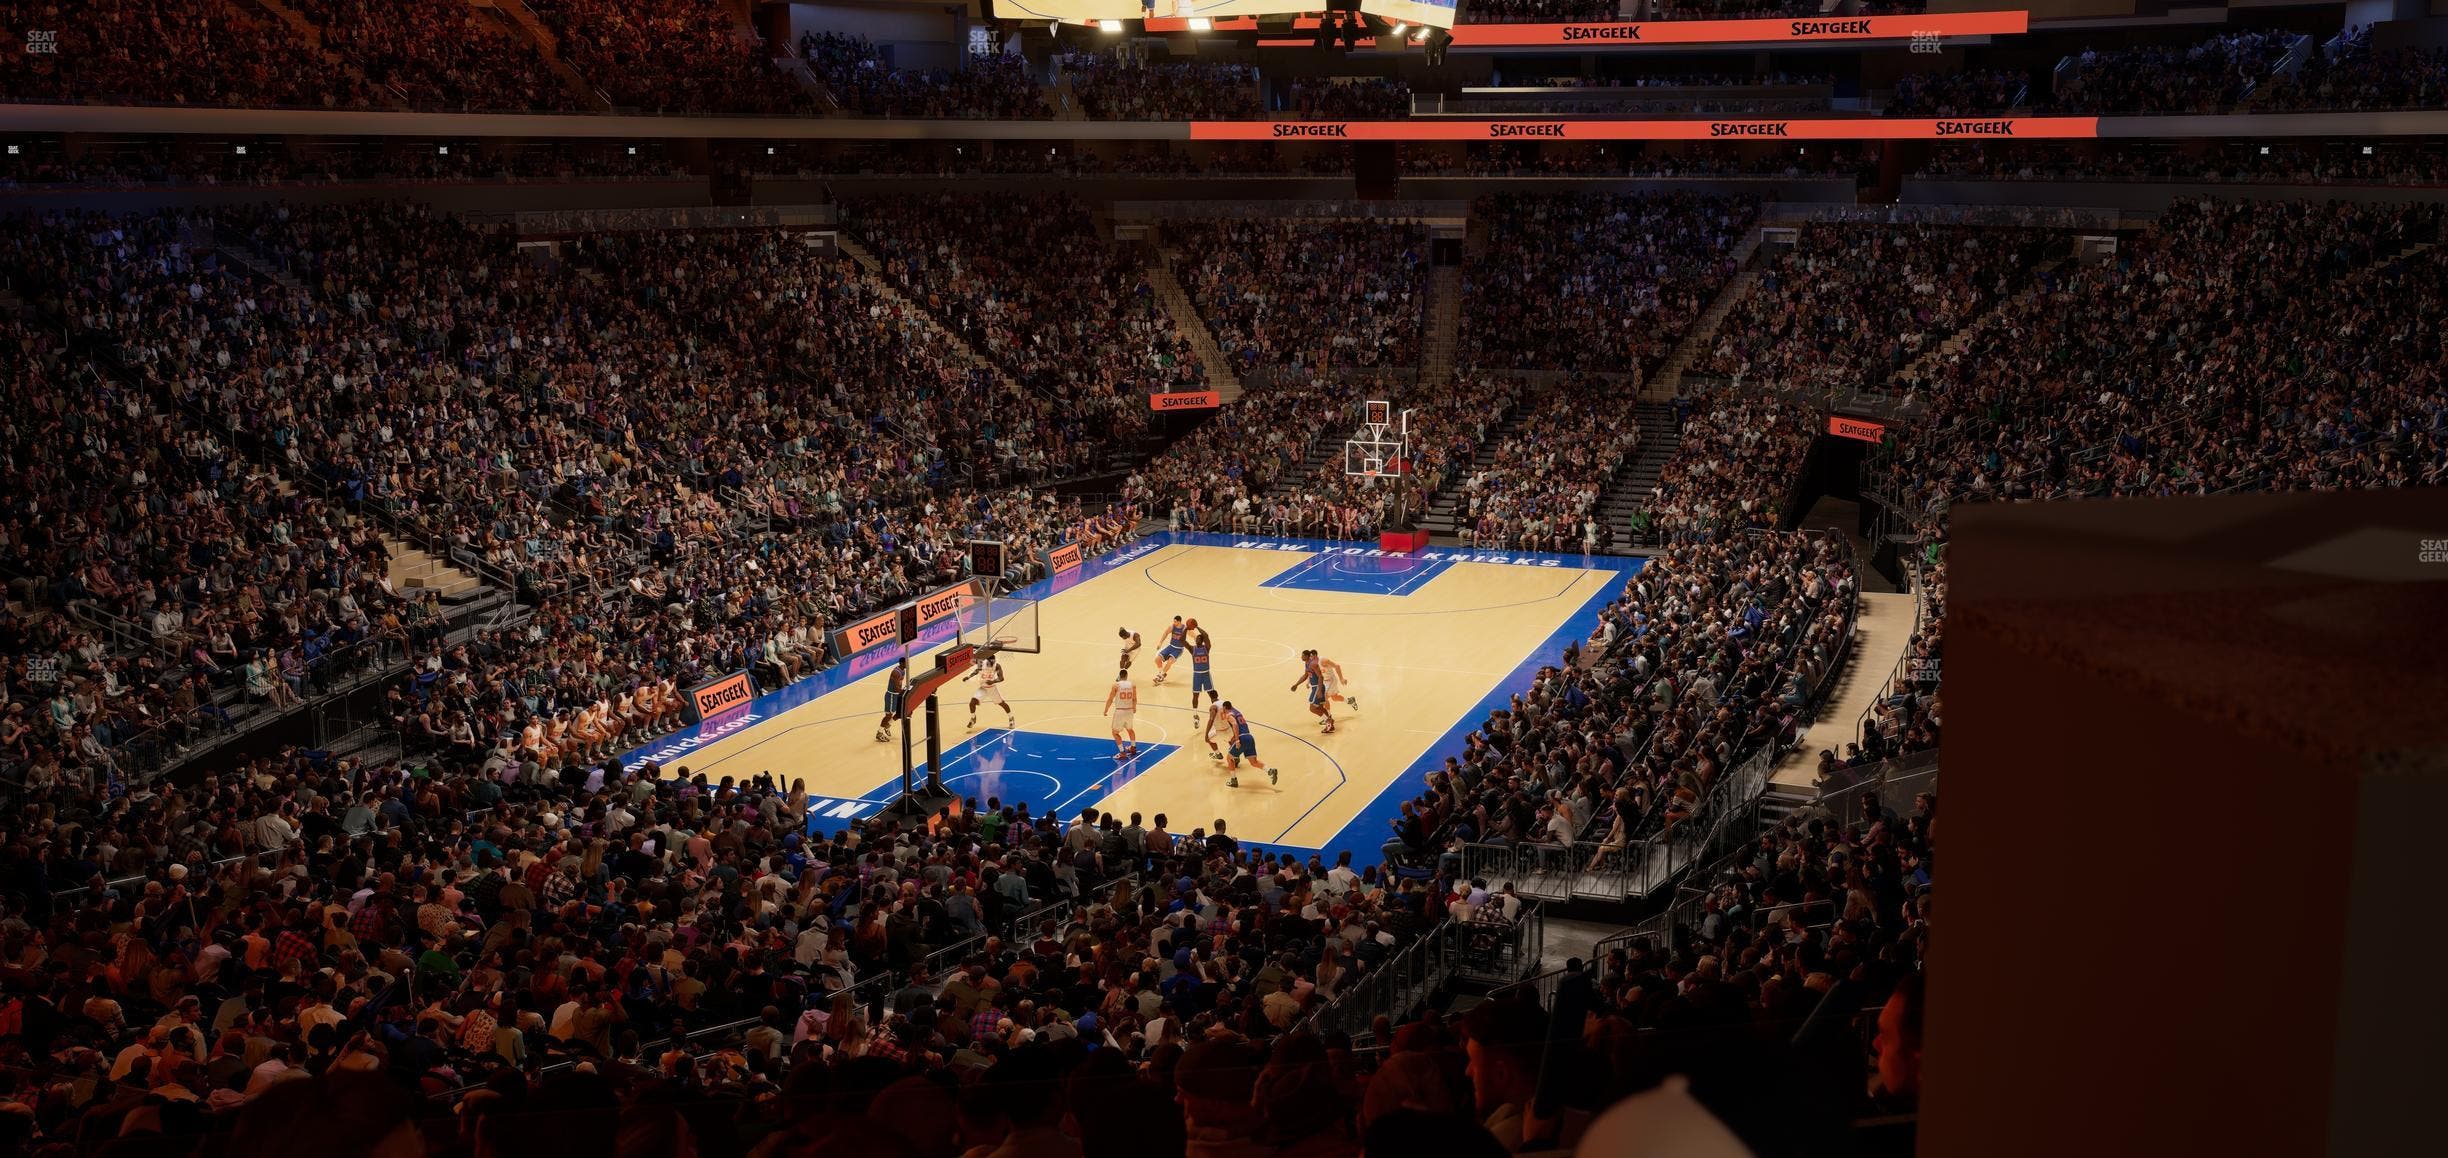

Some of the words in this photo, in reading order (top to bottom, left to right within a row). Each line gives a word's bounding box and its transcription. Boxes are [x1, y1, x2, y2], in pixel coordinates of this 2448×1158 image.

[1563, 26, 1640, 40] SEATGEEK
[1791, 20, 1871, 35] SEATGEEK
[1273, 124, 1347, 137] SEATGEEK
[1490, 124, 1565, 137] SEATGEEK
[1711, 122, 1788, 137] SEATGEEK
[1936, 120, 2013, 136] SEATGEEK
[1162, 396, 1208, 407] SEATGEEK
[1840, 423, 1877, 438] SEATGEEK
[1052, 550, 1080, 570] SEATGEEK
[1232, 542, 1309, 551] NEW
[1421, 552, 1561, 567] KNICKS
[858, 617, 896, 647] SEATGEE
[700, 680, 749, 714] SEATGEEK
